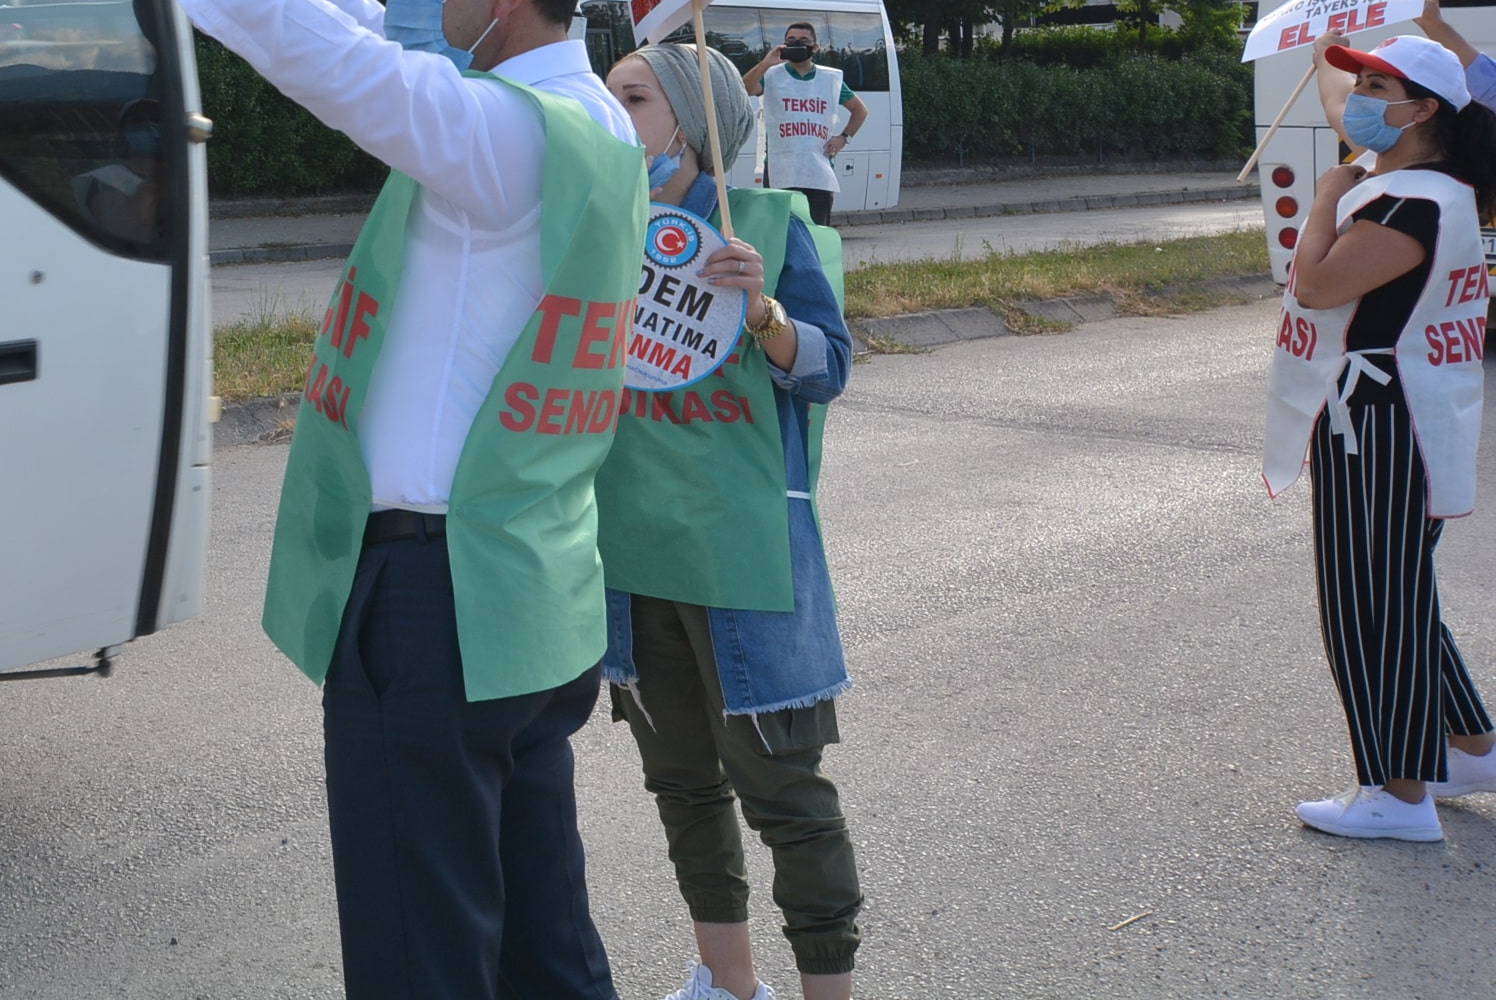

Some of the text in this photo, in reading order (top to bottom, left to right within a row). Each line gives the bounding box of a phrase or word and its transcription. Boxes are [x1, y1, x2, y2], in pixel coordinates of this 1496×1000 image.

[1277, 22, 1315, 51] EL
[1327, 1, 1387, 37] ELE
[782, 96, 827, 115] TEKSİF
[779, 119, 829, 141] SENDİKASI
[628, 334, 693, 380] NMA
[1276, 307, 1317, 361] ASI
[499, 381, 620, 435] SEND
